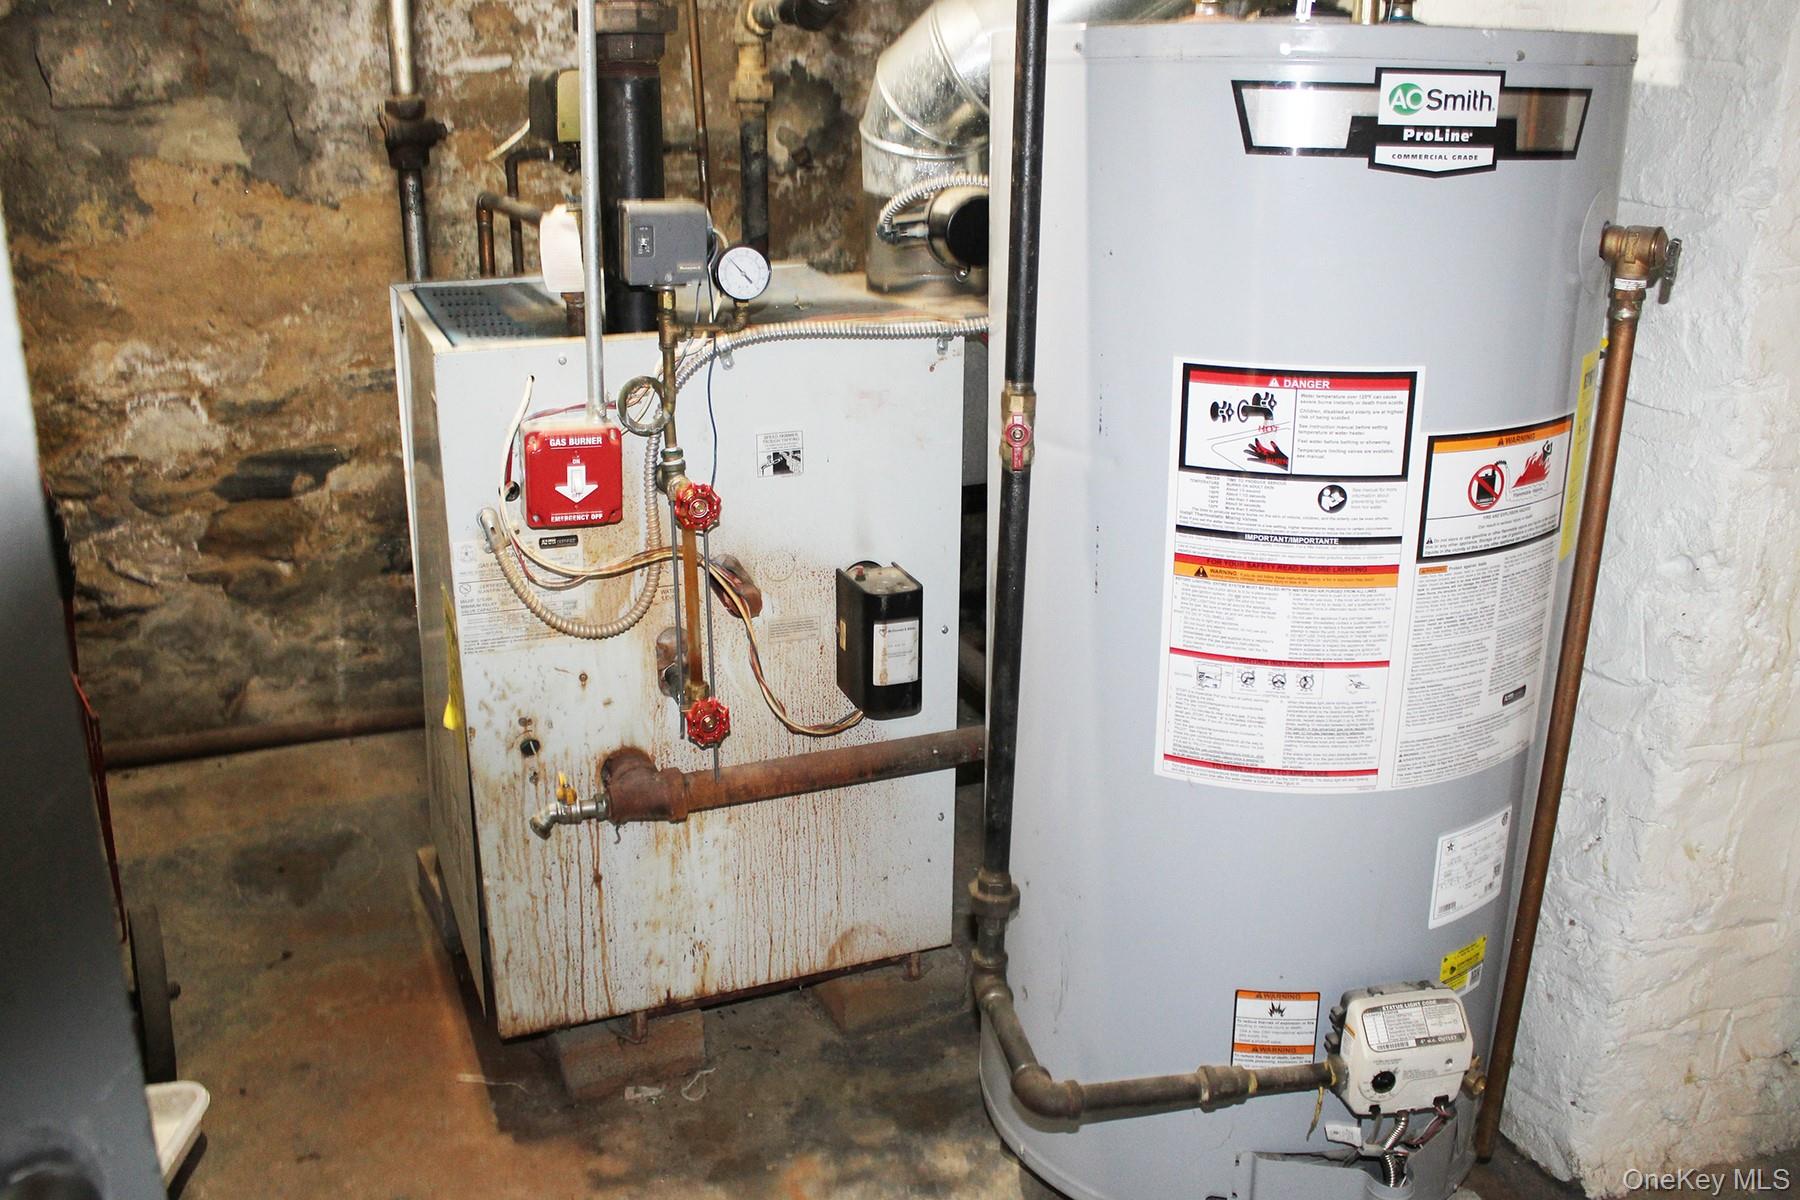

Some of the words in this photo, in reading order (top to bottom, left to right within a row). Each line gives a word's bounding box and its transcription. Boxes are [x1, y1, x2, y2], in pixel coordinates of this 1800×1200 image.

[1426, 89, 1492, 112] Smith
[1402, 128, 1470, 143] ProLine
[1391, 153, 1449, 161] COMMERCIAL
[1283, 378, 1331, 389] DANGER
[549, 438, 567, 447] GAS
[568, 436, 603, 446] BURNER
[550, 514, 590, 522] EMERGENCY
